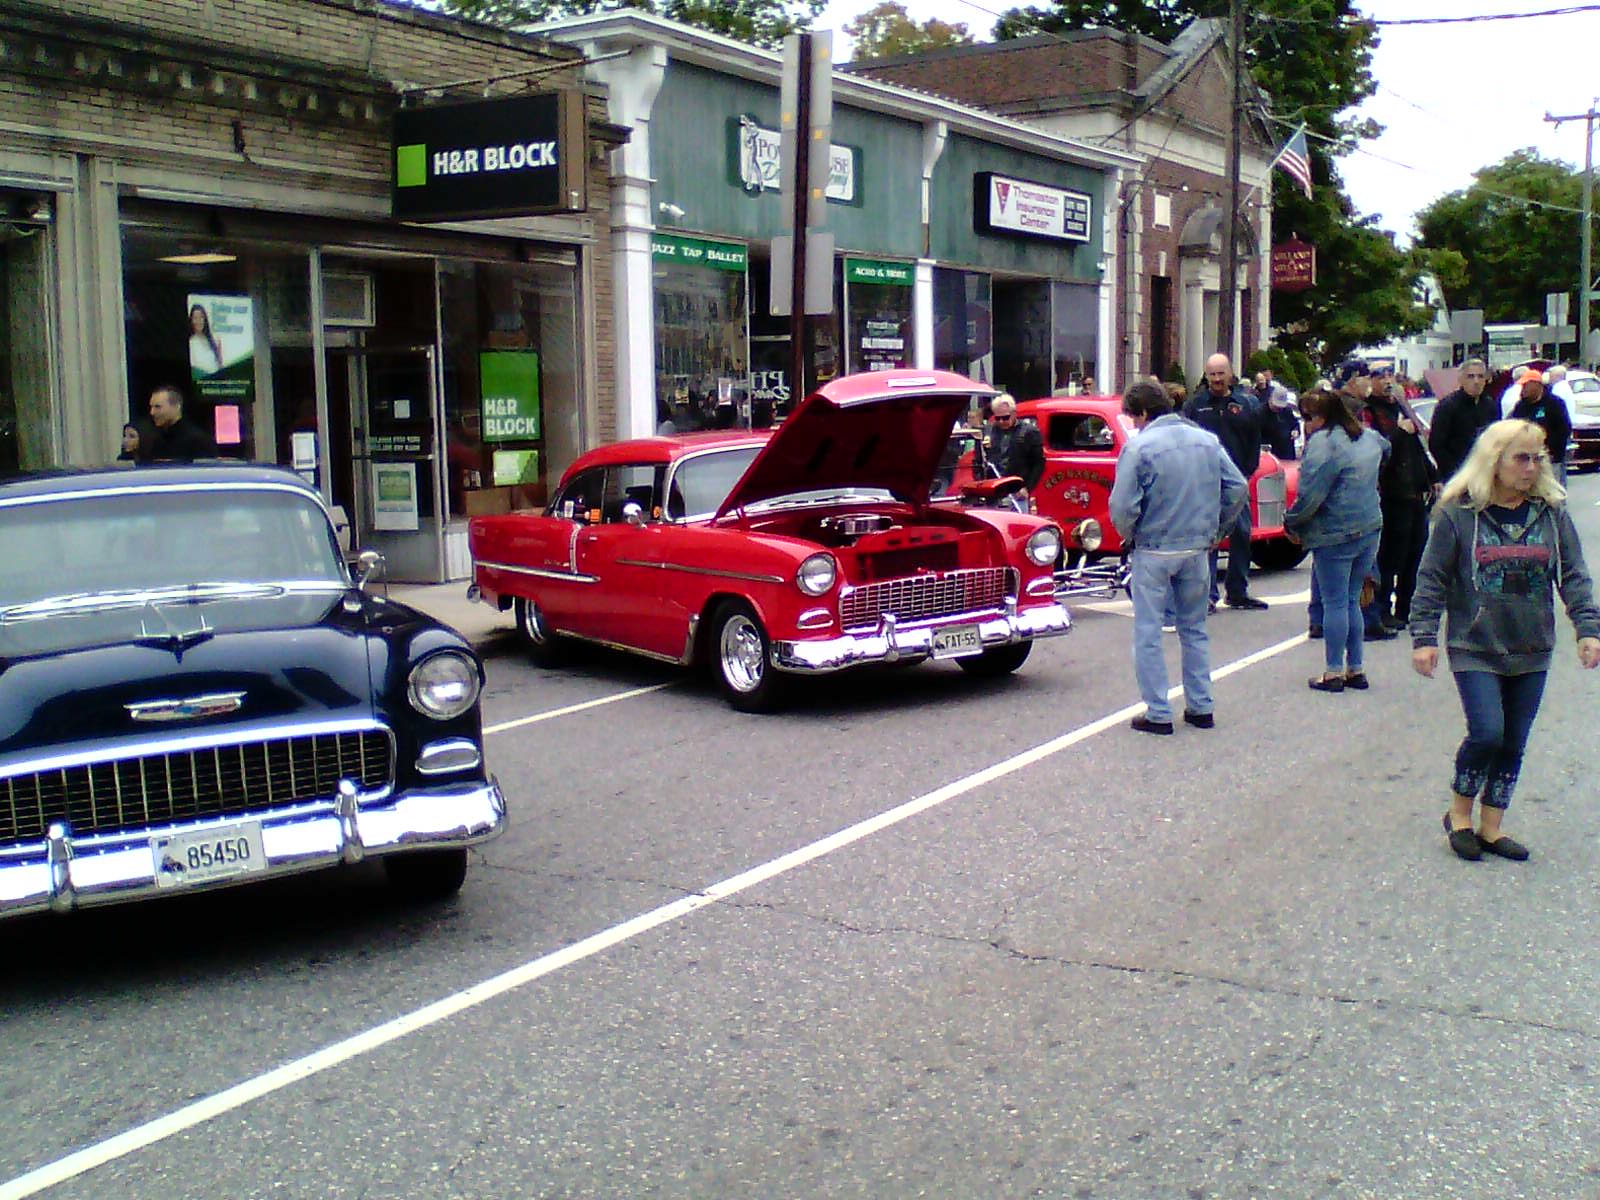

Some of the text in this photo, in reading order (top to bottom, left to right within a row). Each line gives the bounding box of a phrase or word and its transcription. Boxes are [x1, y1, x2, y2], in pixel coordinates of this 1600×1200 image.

[434, 142, 557, 175] H&R BLOCK
[1020, 214, 1050, 229] Center
[707, 249, 745, 263] BALLET
[484, 398, 517, 416] H&R
[485, 417, 536, 436] BLOCK
[187, 837, 250, 870] 85450
